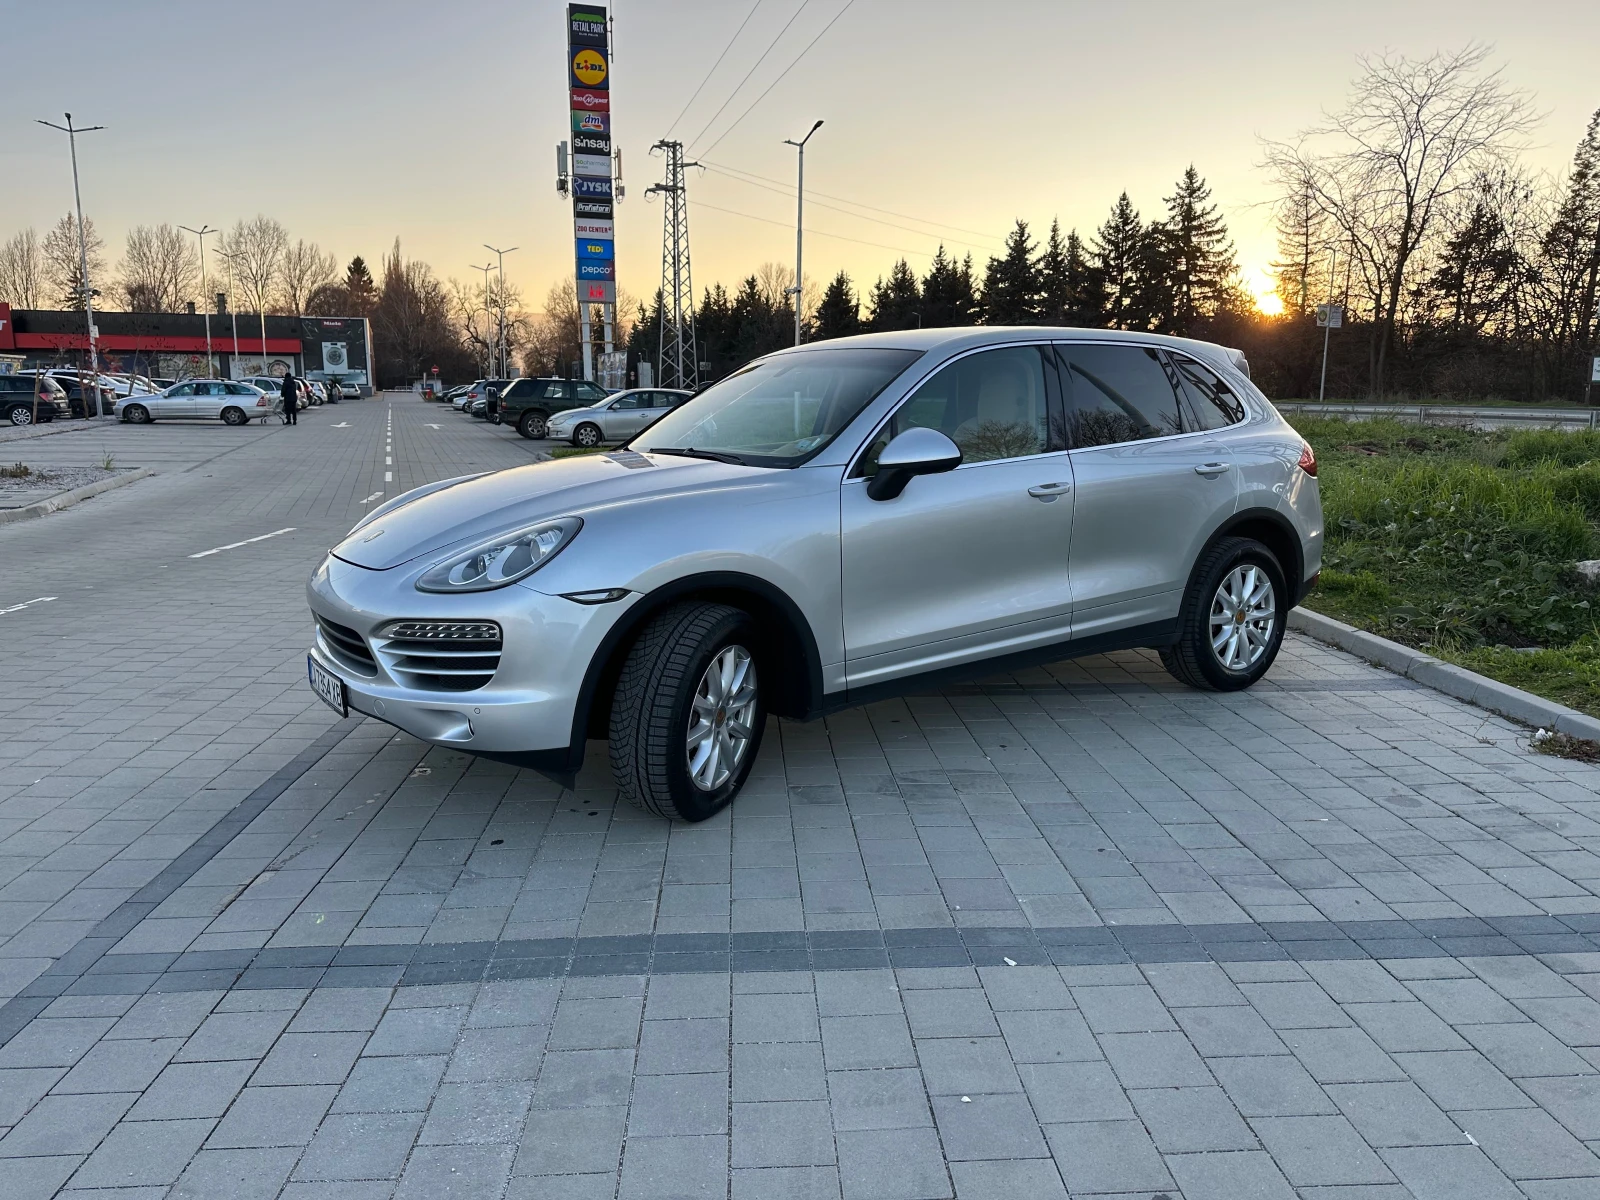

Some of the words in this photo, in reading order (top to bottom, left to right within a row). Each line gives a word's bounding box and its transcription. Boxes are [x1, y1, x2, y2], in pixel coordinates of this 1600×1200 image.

[572, 21, 590, 32] RETAIL
[591, 22, 605, 34] PARK
[584, 113, 600, 124] dm
[574, 136, 610, 152] sinsay
[582, 181, 611, 192] JYSK
[581, 265, 611, 275] pepco
